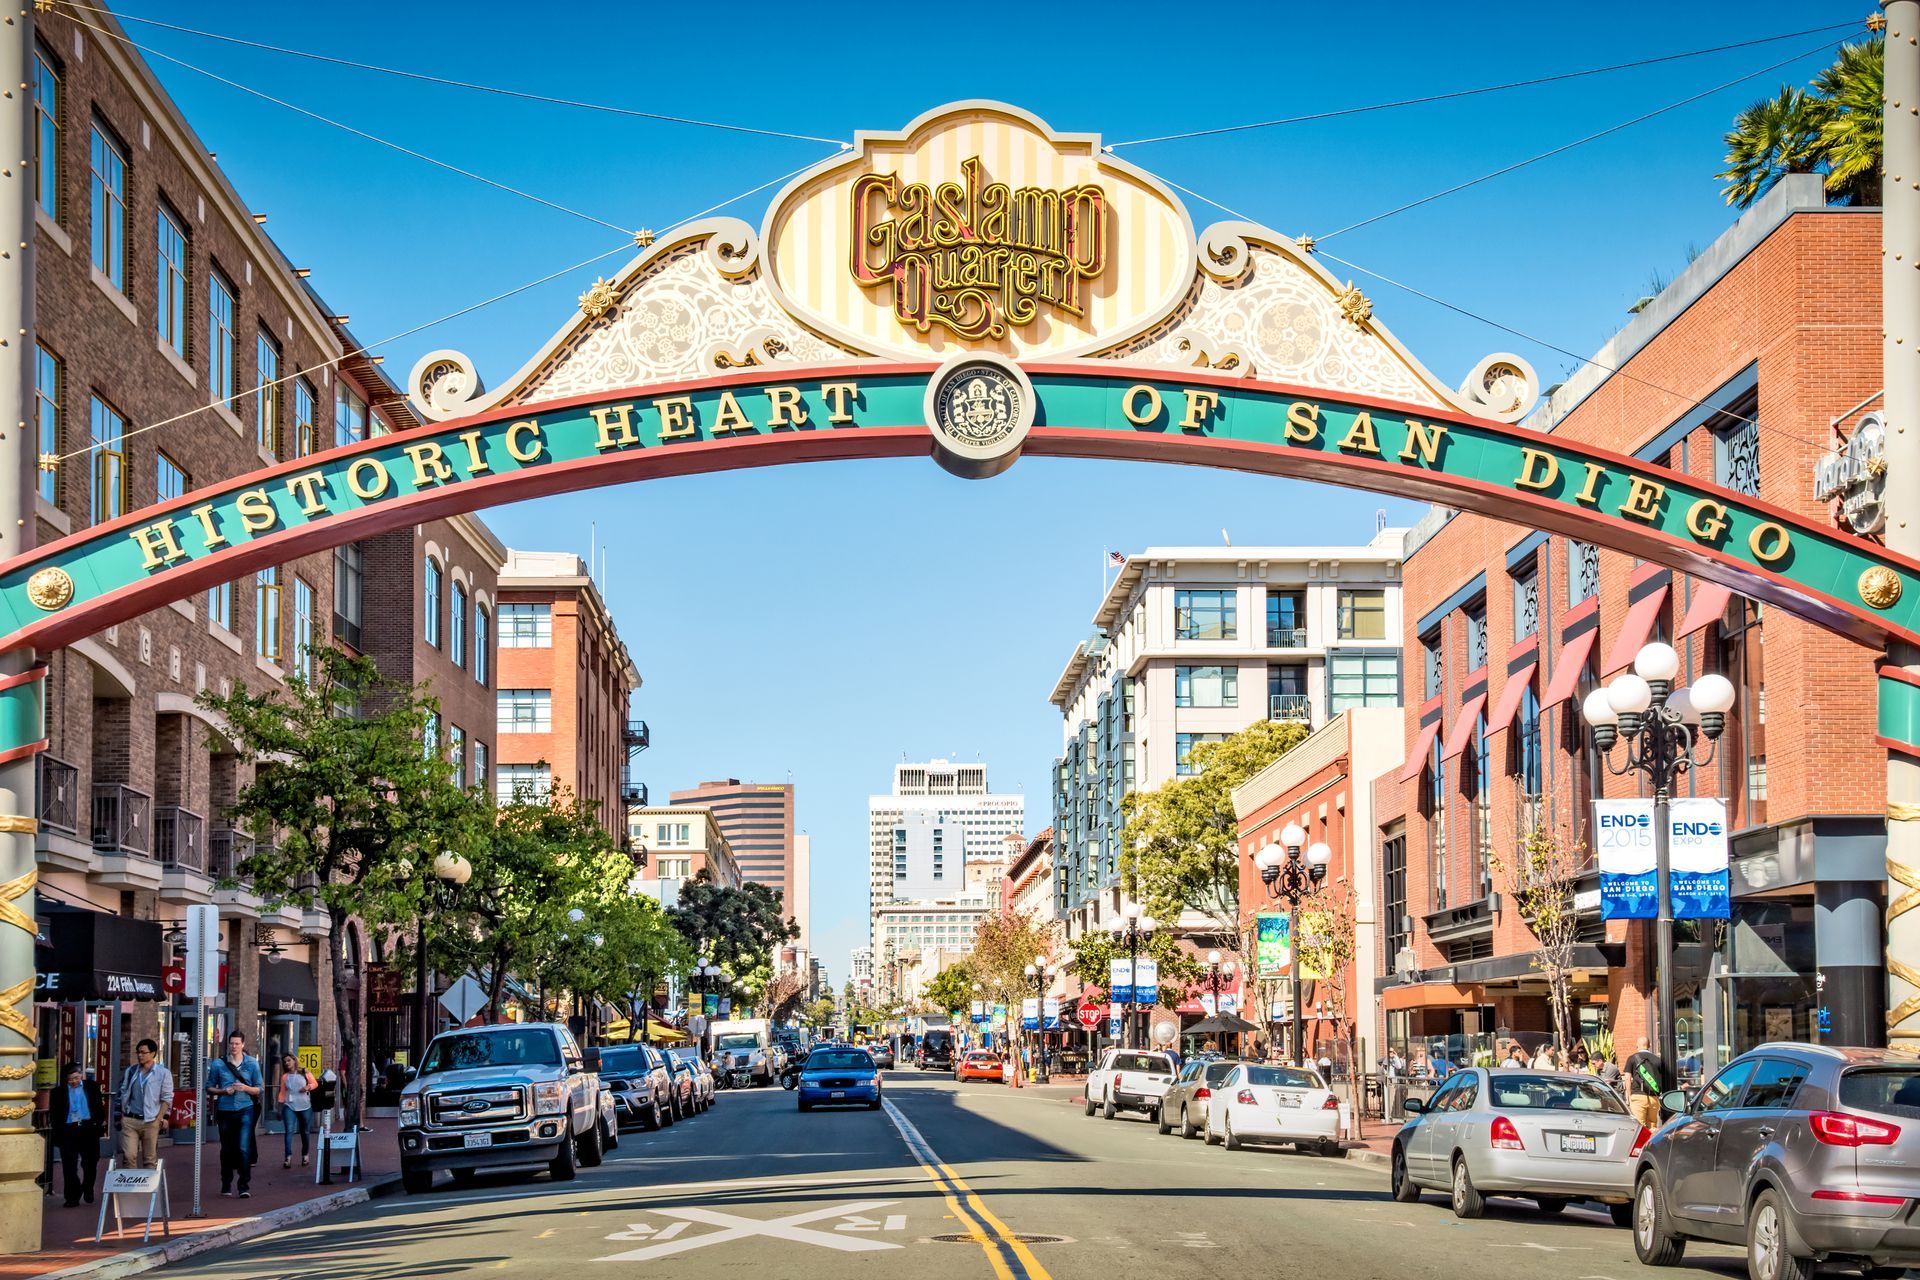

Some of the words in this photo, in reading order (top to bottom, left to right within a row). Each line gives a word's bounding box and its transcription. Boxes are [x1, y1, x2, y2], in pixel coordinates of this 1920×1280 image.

[849, 155, 1107, 287] Gaslamp
[893, 245, 1084, 341] Quarter
[945, 381, 955, 393] SAN
[955, 370, 977, 381] DIEGO
[131, 420, 543, 570] HISTORIC
[589, 382, 858, 450] HEART
[1122, 385, 1219, 430] OF
[1284, 402, 1448, 463] SAN
[1513, 447, 1790, 562] DIEGO
[1601, 814, 1650, 828] ENDO
[1672, 822, 1722, 836] ENDO
[1602, 829, 1652, 848] 2015
[1673, 837, 1703, 845] EXPO
[107, 975, 120, 991] 224
[120, 976, 135, 992] Fifth
[1080, 1010, 1099, 1019] STOP
[300, 1054, 318, 1068] $16
